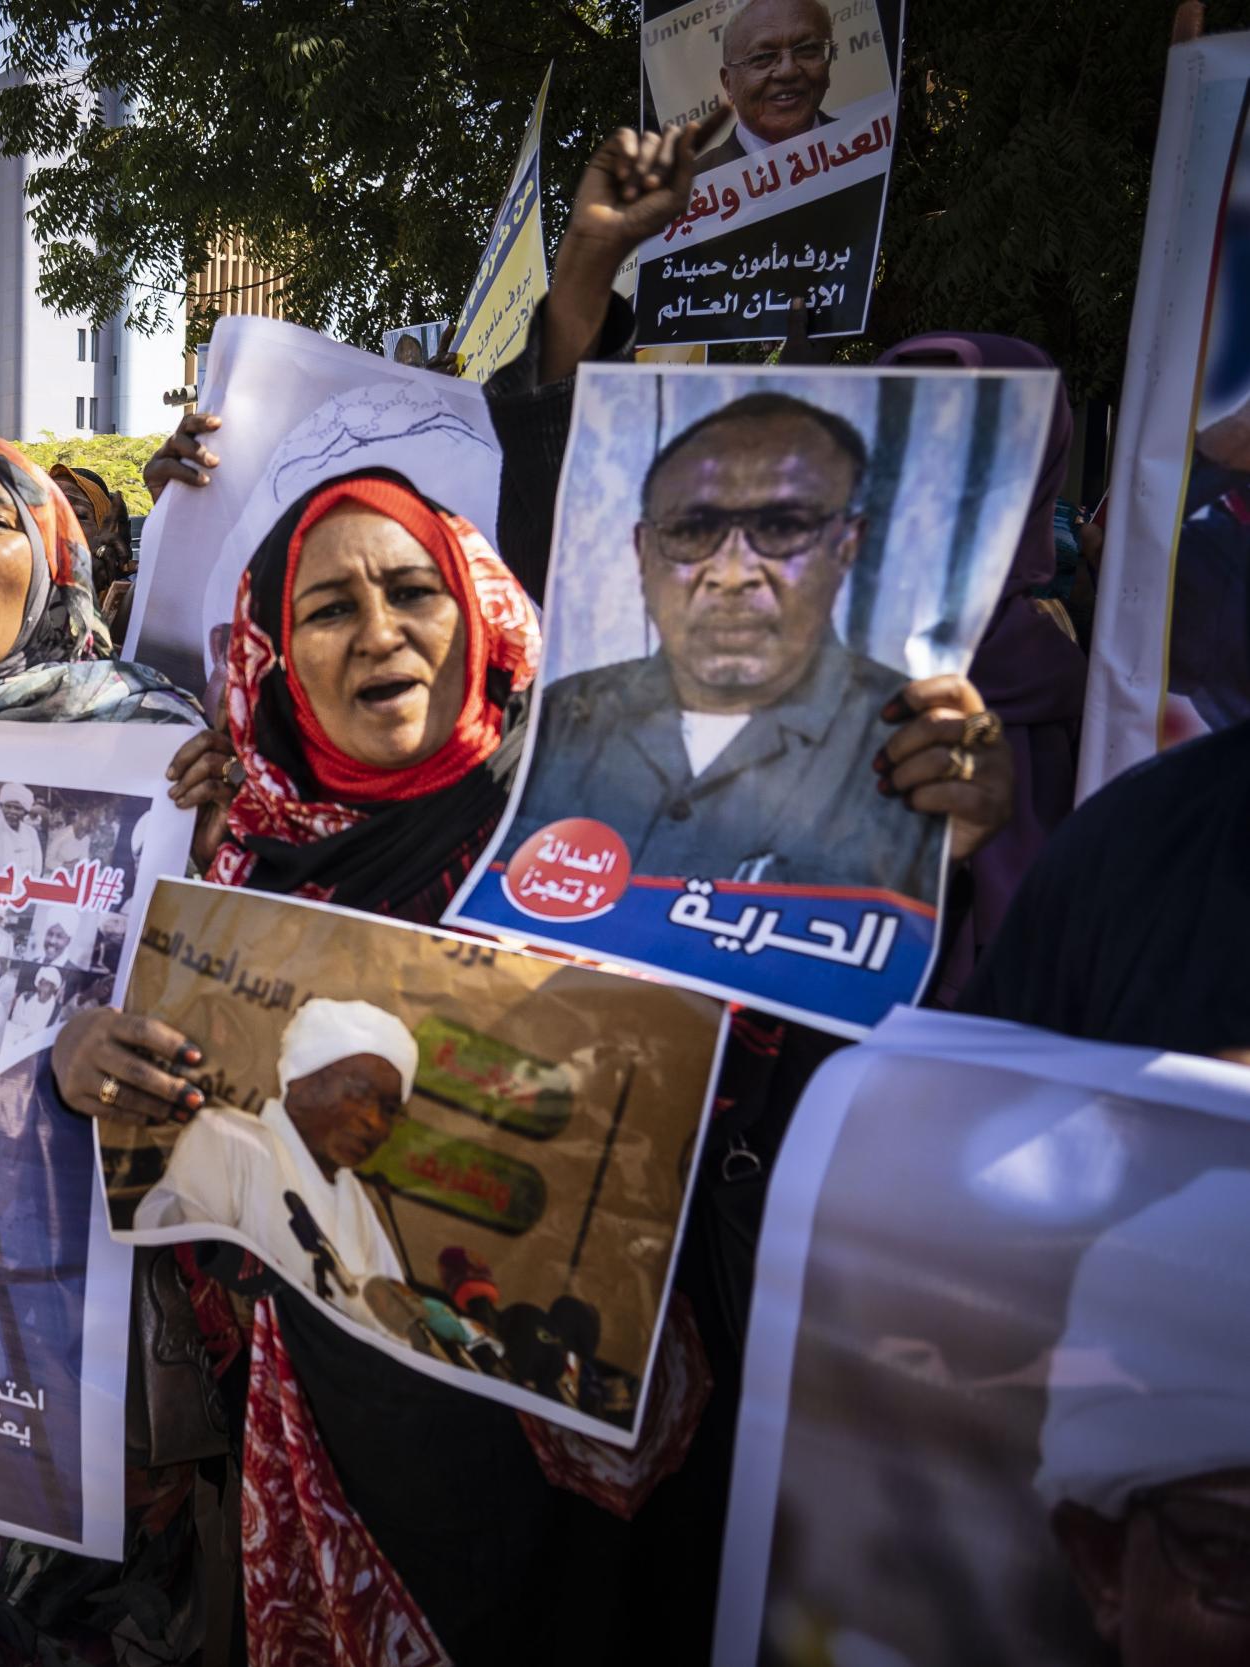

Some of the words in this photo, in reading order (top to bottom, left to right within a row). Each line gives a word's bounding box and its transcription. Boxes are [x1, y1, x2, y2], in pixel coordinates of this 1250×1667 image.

[789, 116, 892, 187] العدالة
[742, 160, 781, 200] لنا
[662, 256, 727, 283] حميدة
[731, 242, 788, 280] مأمون
[793, 243, 851, 273] بروف
[505, 266, 532, 312] بروف
[536, 833, 617, 874] العدالة
[669, 877, 900, 972] الحرية
